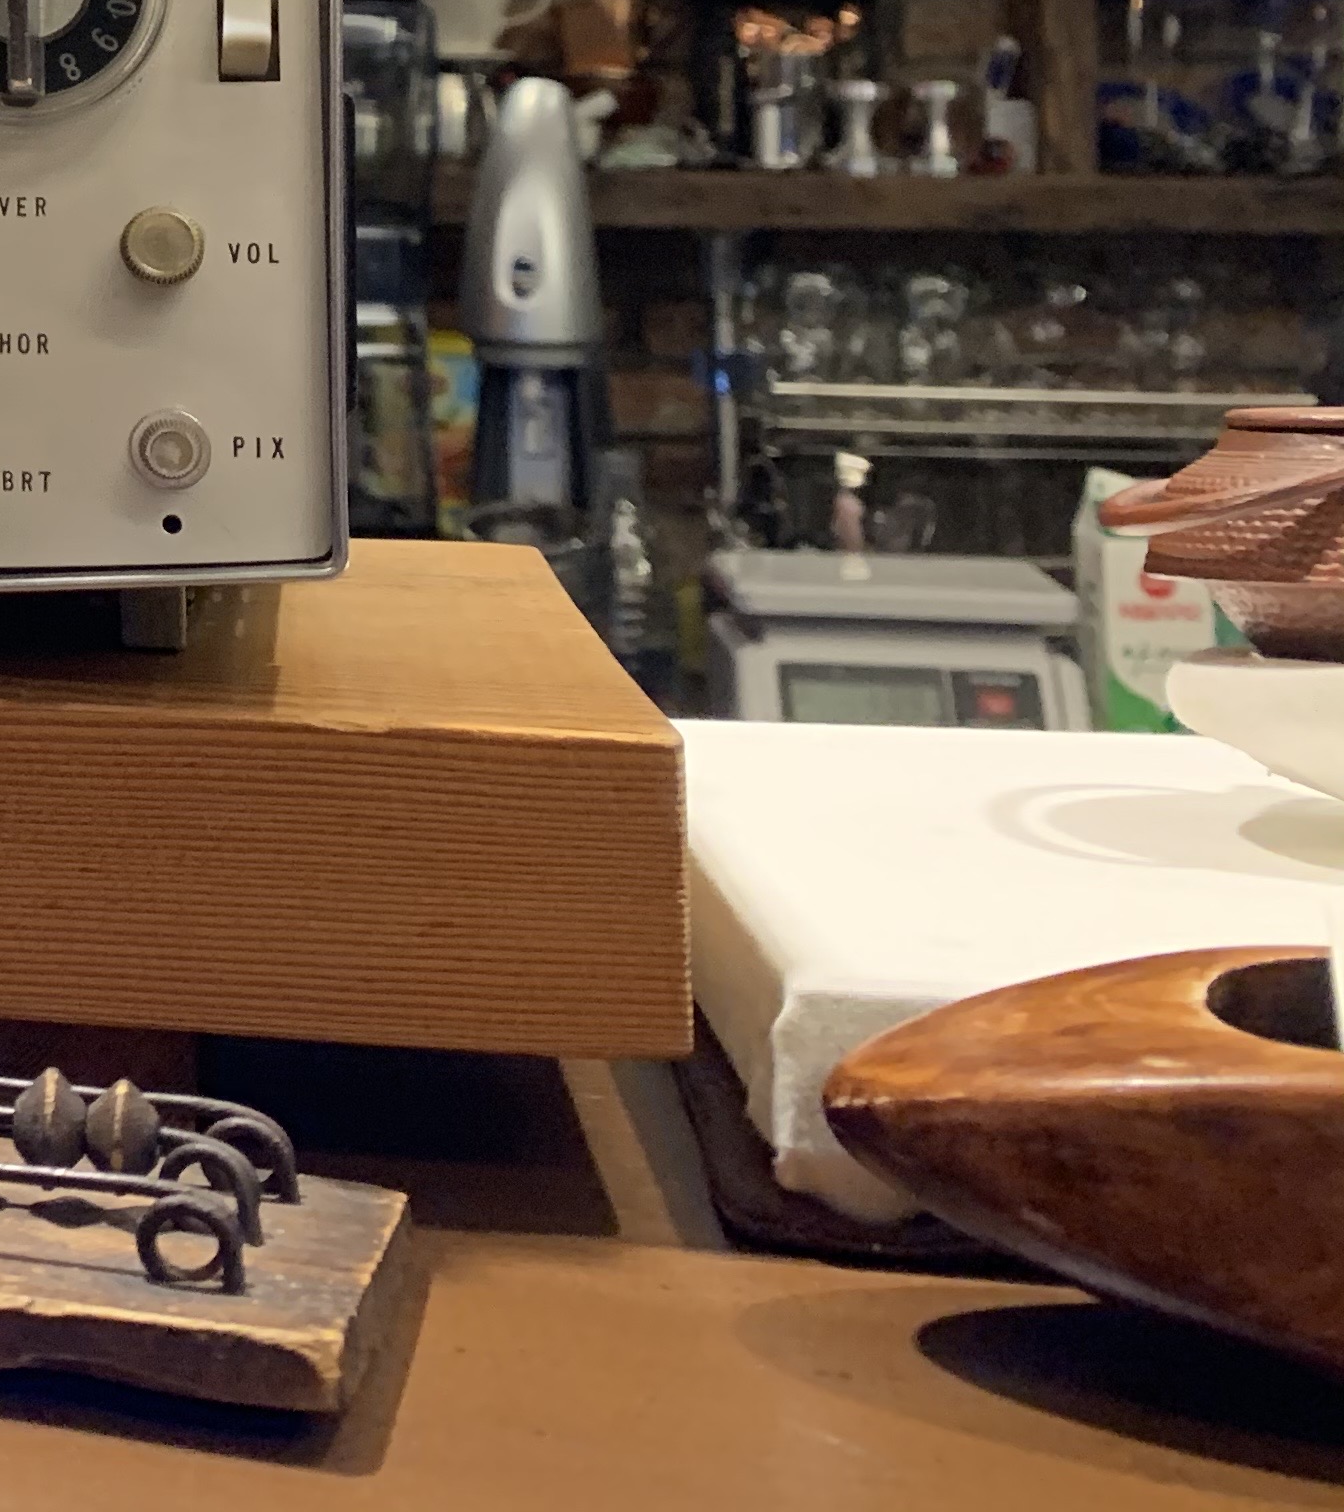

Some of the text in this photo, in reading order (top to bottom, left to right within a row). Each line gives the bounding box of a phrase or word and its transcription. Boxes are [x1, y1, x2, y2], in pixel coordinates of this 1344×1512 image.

[91, 27, 119, 52] 9
[59, 52, 81, 82] 8
[227, 242, 280, 265] VOL
[232, 436, 286, 460] PIX
[2, 471, 52, 493] BRT
